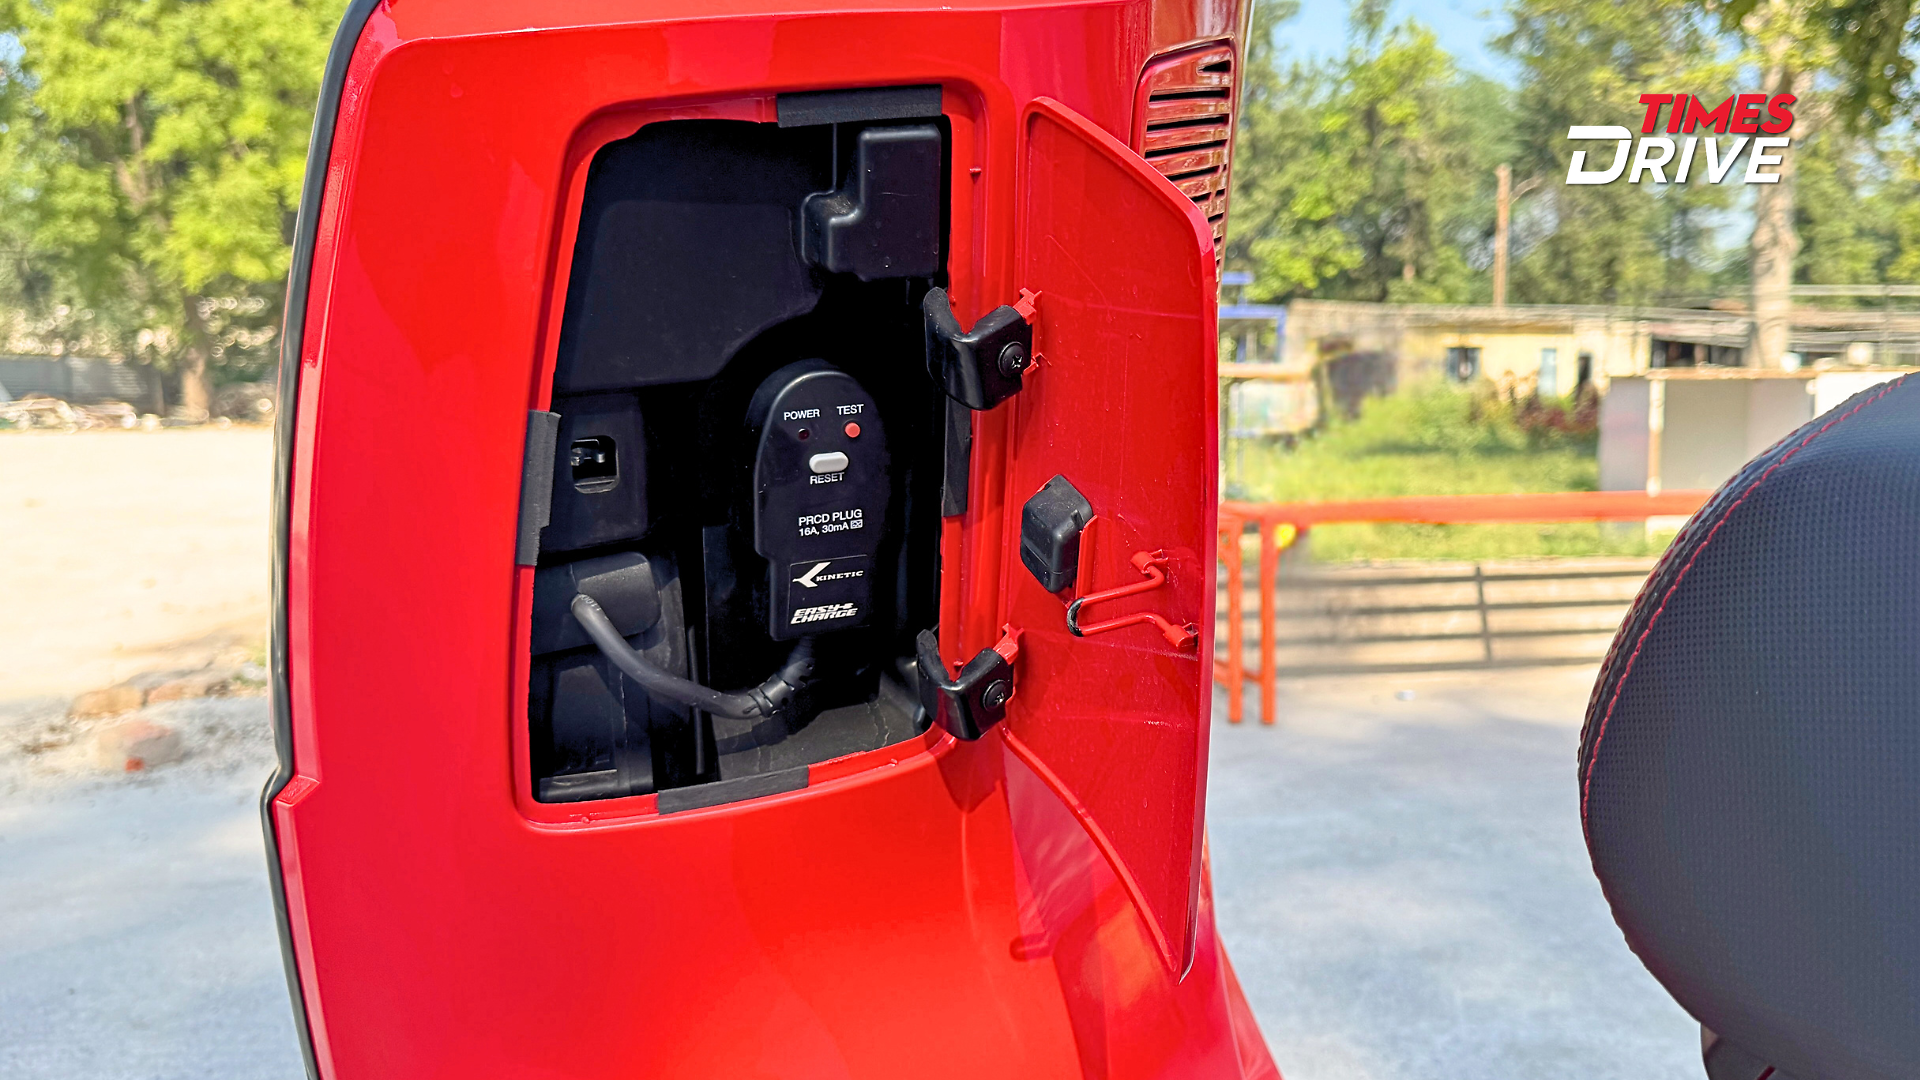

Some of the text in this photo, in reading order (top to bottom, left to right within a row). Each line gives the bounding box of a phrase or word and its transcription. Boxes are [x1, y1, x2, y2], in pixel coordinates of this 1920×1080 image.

[783, 408, 821, 421] POWER
[836, 403, 864, 416] TEST
[809, 471, 845, 485] RESET
[798, 508, 863, 527] PRCD PLUG
[798, 523, 850, 537] 16A, 30mA
[815, 570, 864, 582] KINETIC
[790, 607, 859, 625] CHARGE
